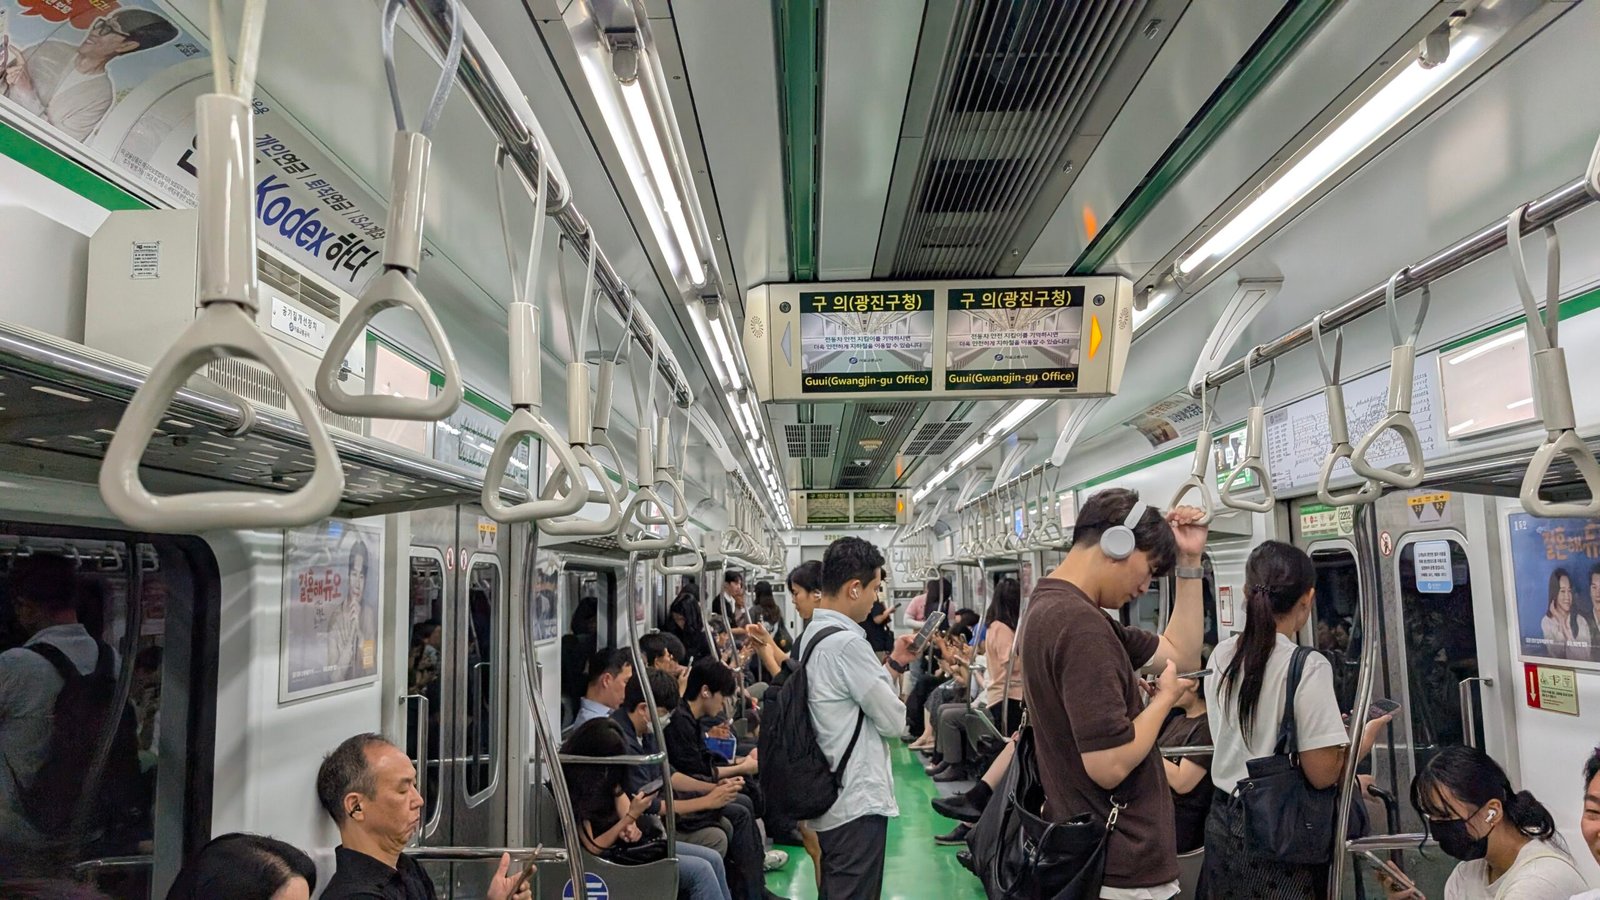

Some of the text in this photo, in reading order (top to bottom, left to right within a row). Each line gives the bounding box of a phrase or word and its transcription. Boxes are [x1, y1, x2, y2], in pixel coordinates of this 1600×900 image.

[256, 133, 311, 174] 개인연금
[305, 179, 355, 212] 퇴직연금
[257, 174, 378, 282] Kodex하다
[813, 293, 921, 312] 구 의(광진구청)
[961, 290, 1071, 308] 구 의(광진구청)
[805, 375, 928, 387] Guui(Gwangjin-gu Office)
[949, 372, 1074, 384] Guui(Gwangjin-gu Office)
